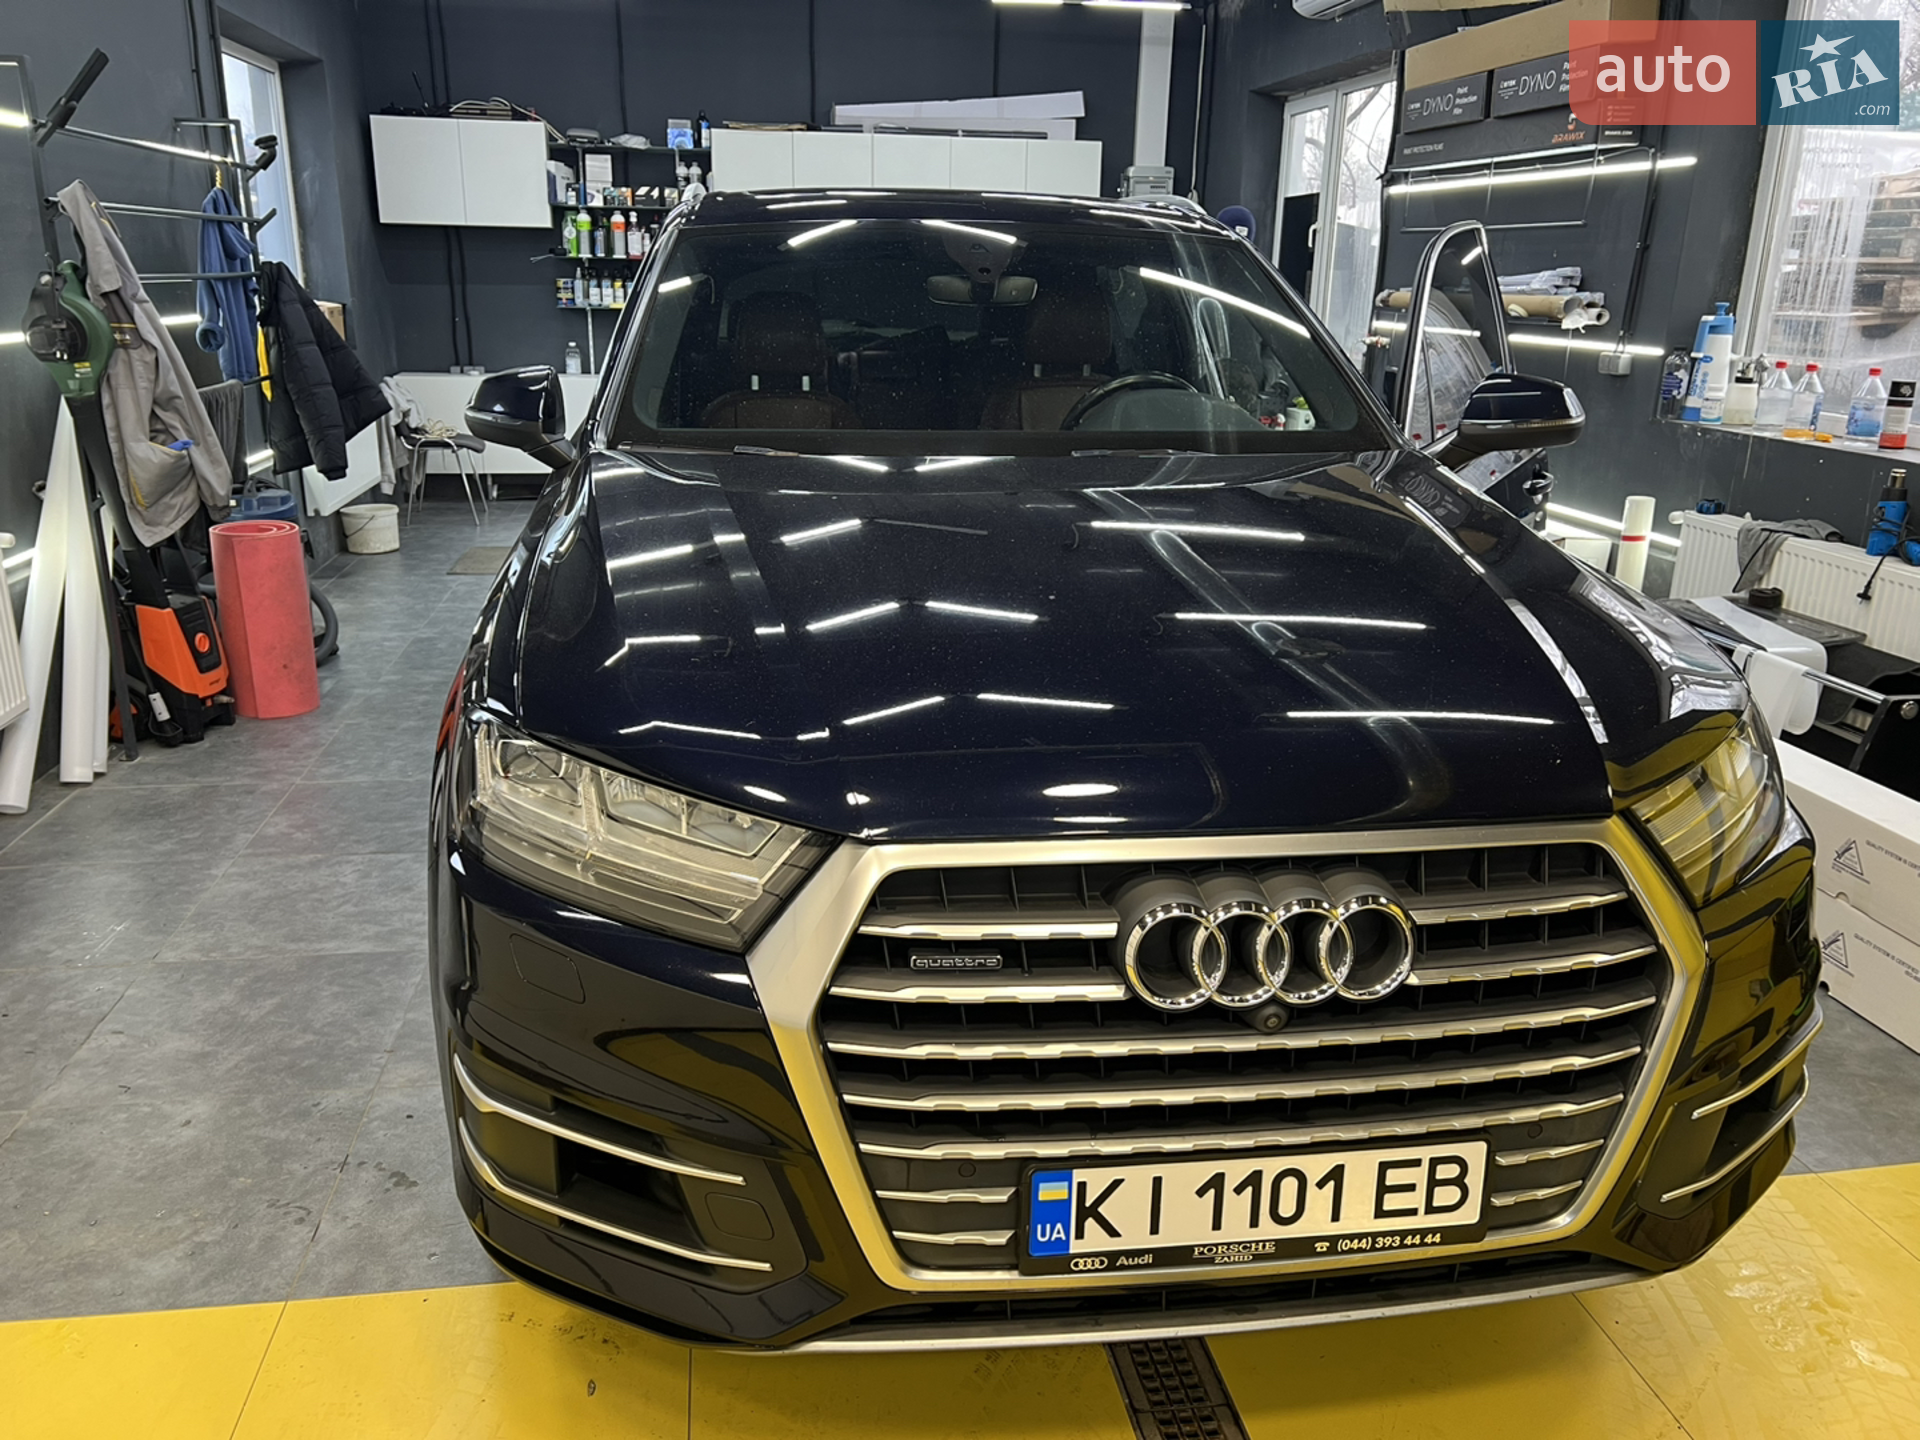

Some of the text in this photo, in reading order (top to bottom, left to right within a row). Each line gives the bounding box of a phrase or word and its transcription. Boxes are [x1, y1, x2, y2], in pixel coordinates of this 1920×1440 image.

[1519, 70, 1557, 96] DYNO
[1423, 93, 1454, 116] DYNO
[916, 958, 998, 968] quattro
[1075, 1155, 1469, 1240] KI 1101 EB
[1037, 1222, 1066, 1242] UA
[1193, 1241, 1276, 1257] PORSCHE
[1337, 1233, 1441, 1252] (044) 393 44 44
[1116, 1254, 1153, 1266] Audi
